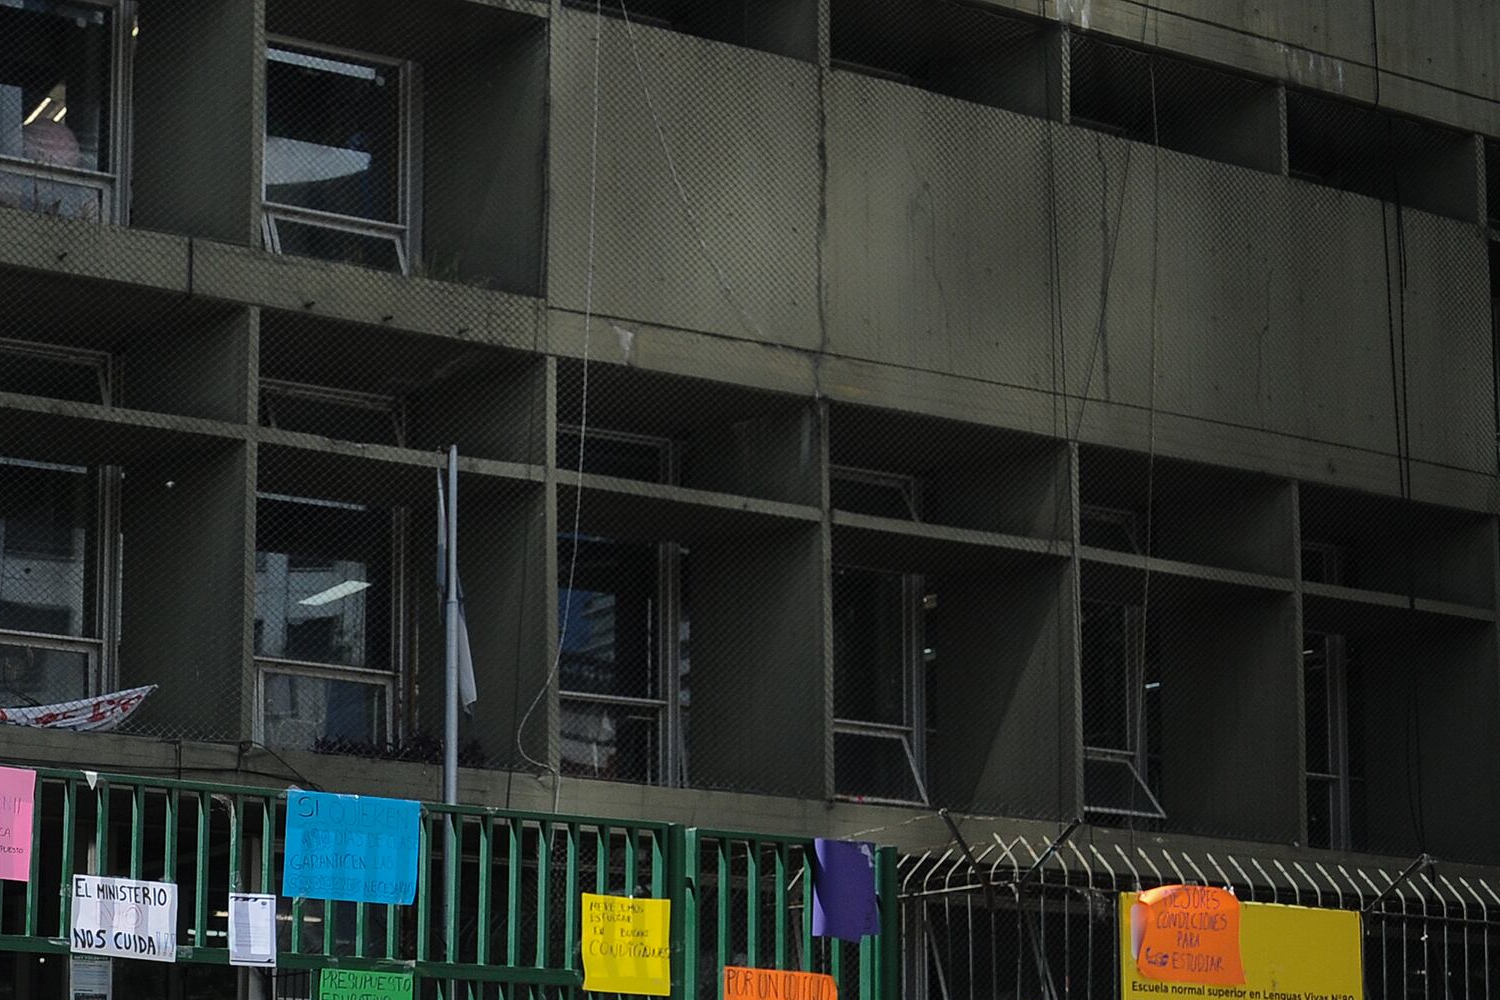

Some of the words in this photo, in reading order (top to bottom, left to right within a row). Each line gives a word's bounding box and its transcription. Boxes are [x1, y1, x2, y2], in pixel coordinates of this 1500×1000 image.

[298, 796, 318, 817] SI
[75, 878, 92, 899] EL
[97, 883, 167, 907] MINISTERIO
[96, 901, 143, 930] NO
[1156, 911, 1228, 931] CONDICIONES
[73, 928, 106, 950] NOS
[1177, 931, 1200, 948] PARA
[1172, 951, 1224, 972] ESTUDIAR
[322, 973, 411, 992] PRESUPUESTO
[726, 969, 754, 996] POR
[758, 973, 779, 1000] UN
[1131, 981, 1169, 994] Escuela
[1171, 985, 1206, 996] normal
[1208, 988, 1247, 1000] superior
[1249, 991, 1261, 999] en
